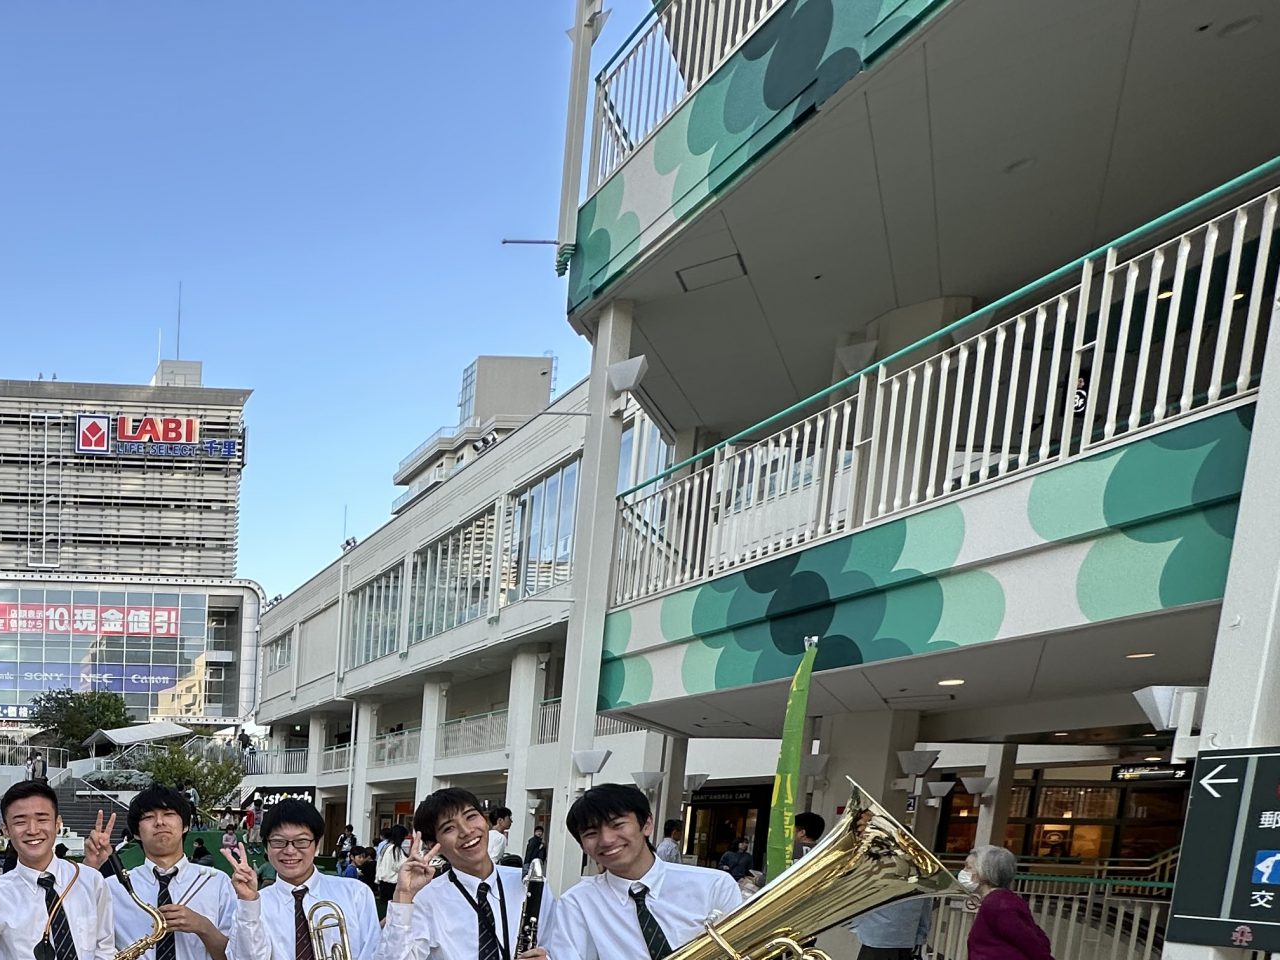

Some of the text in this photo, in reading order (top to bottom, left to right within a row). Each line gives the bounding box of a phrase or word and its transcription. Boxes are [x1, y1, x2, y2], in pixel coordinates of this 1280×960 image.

[117, 416, 198, 443] LABI
[116, 443, 197, 456] LIFE SELECT
[203, 439, 237, 457] 千里
[24, 672, 64, 681] SONY
[80, 673, 114, 683] NEC
[131, 673, 169, 684] Canon
[1174, 770, 1186, 778] 2F
